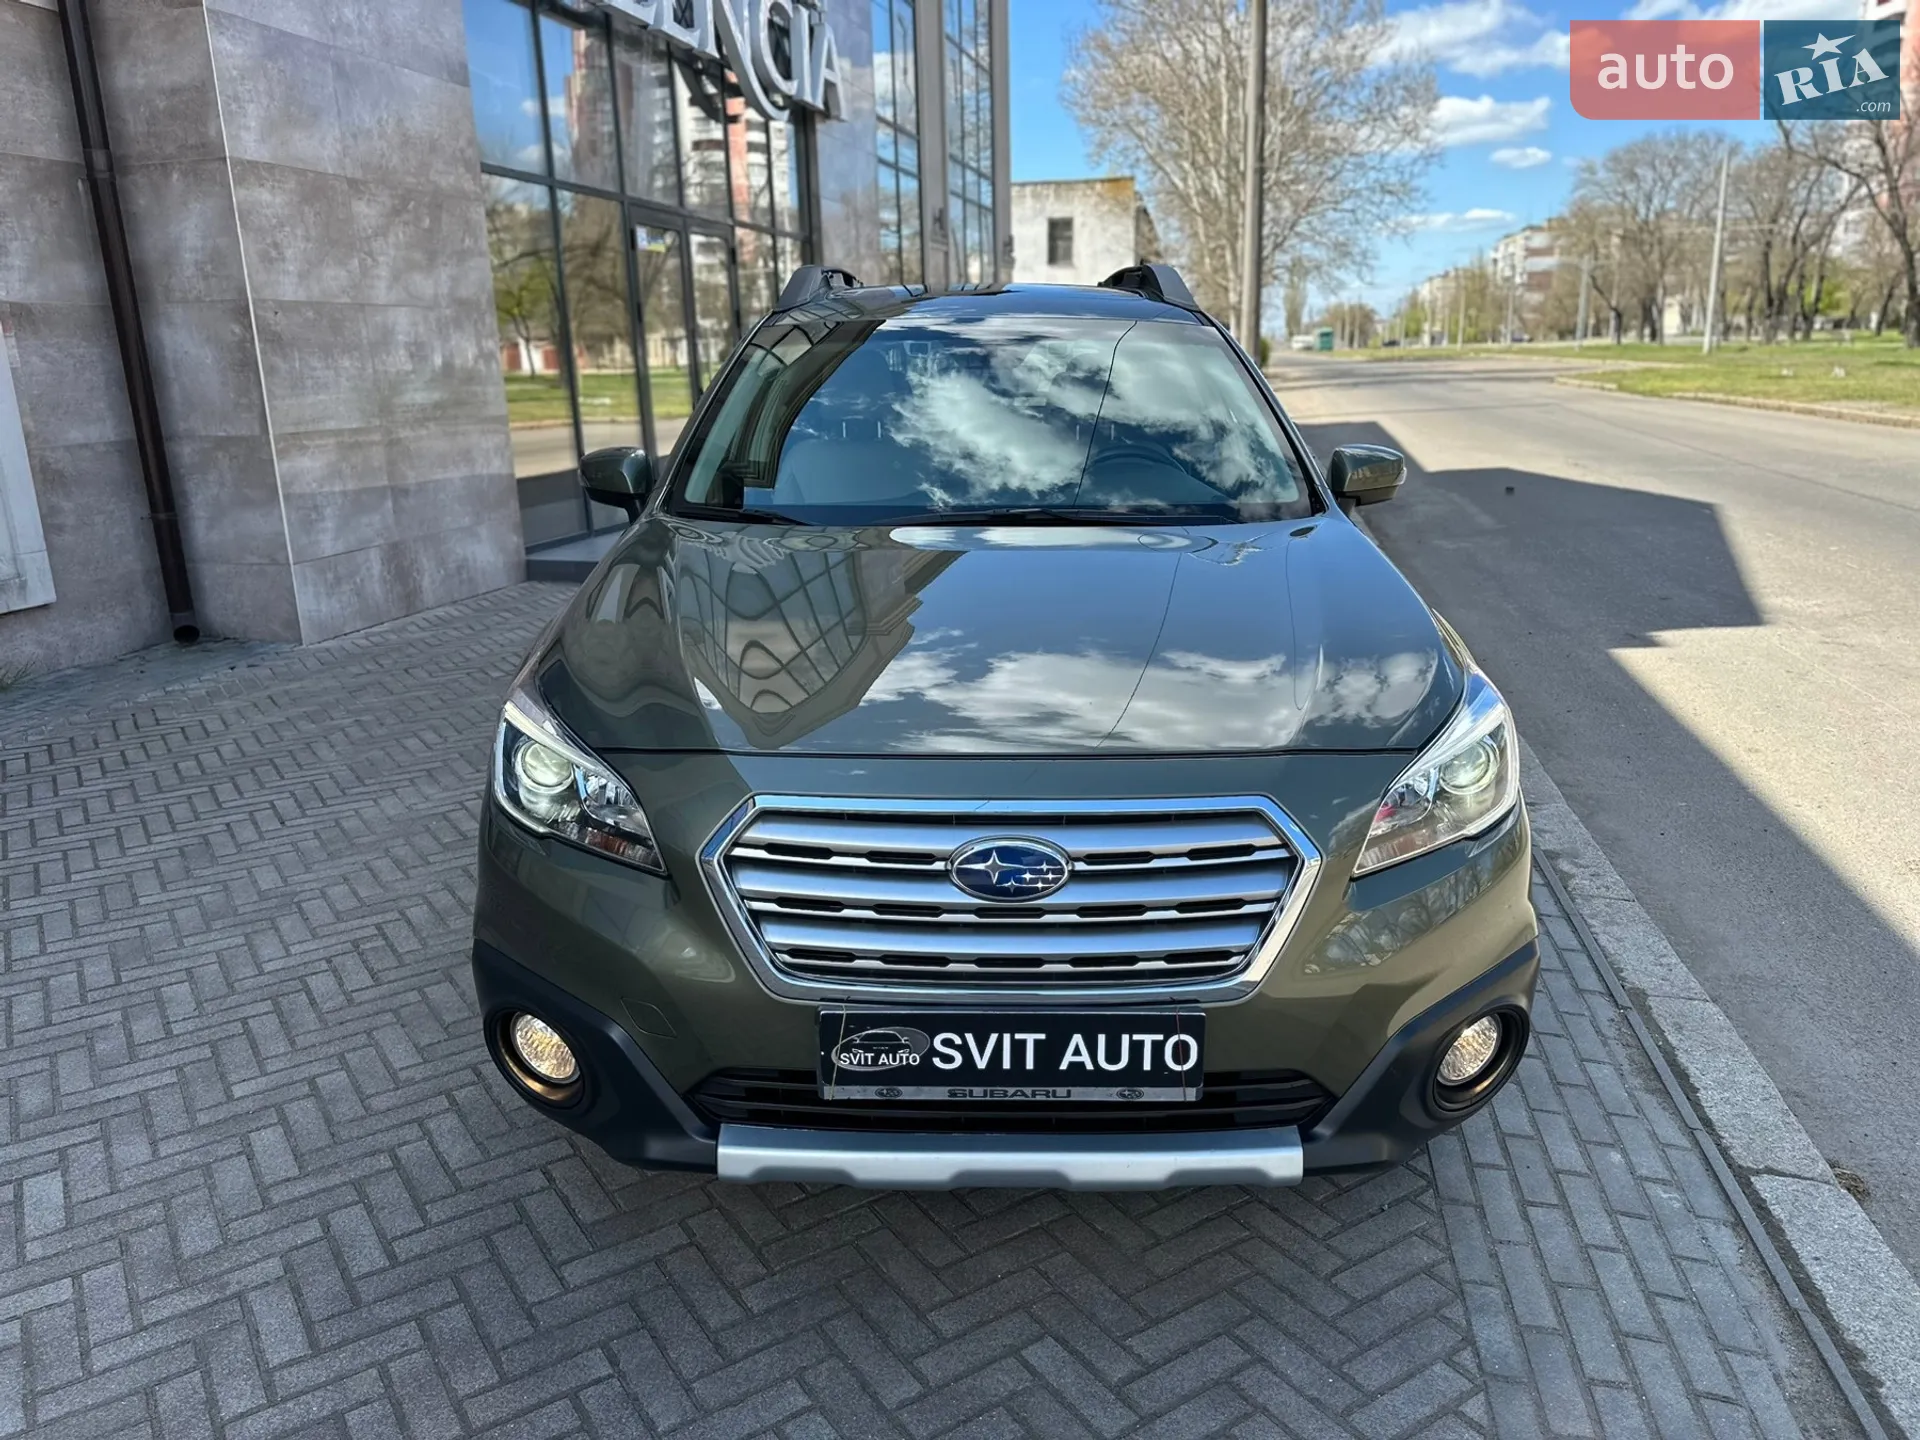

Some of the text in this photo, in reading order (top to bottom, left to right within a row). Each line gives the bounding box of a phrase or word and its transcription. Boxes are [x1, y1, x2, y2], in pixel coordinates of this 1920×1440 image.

[600, 0, 849, 122] NCIA
[840, 1052, 921, 1066] SVIT AUTO
[932, 1032, 1198, 1072] SVIT AUTO
[946, 1087, 1072, 1100] SUBARU
